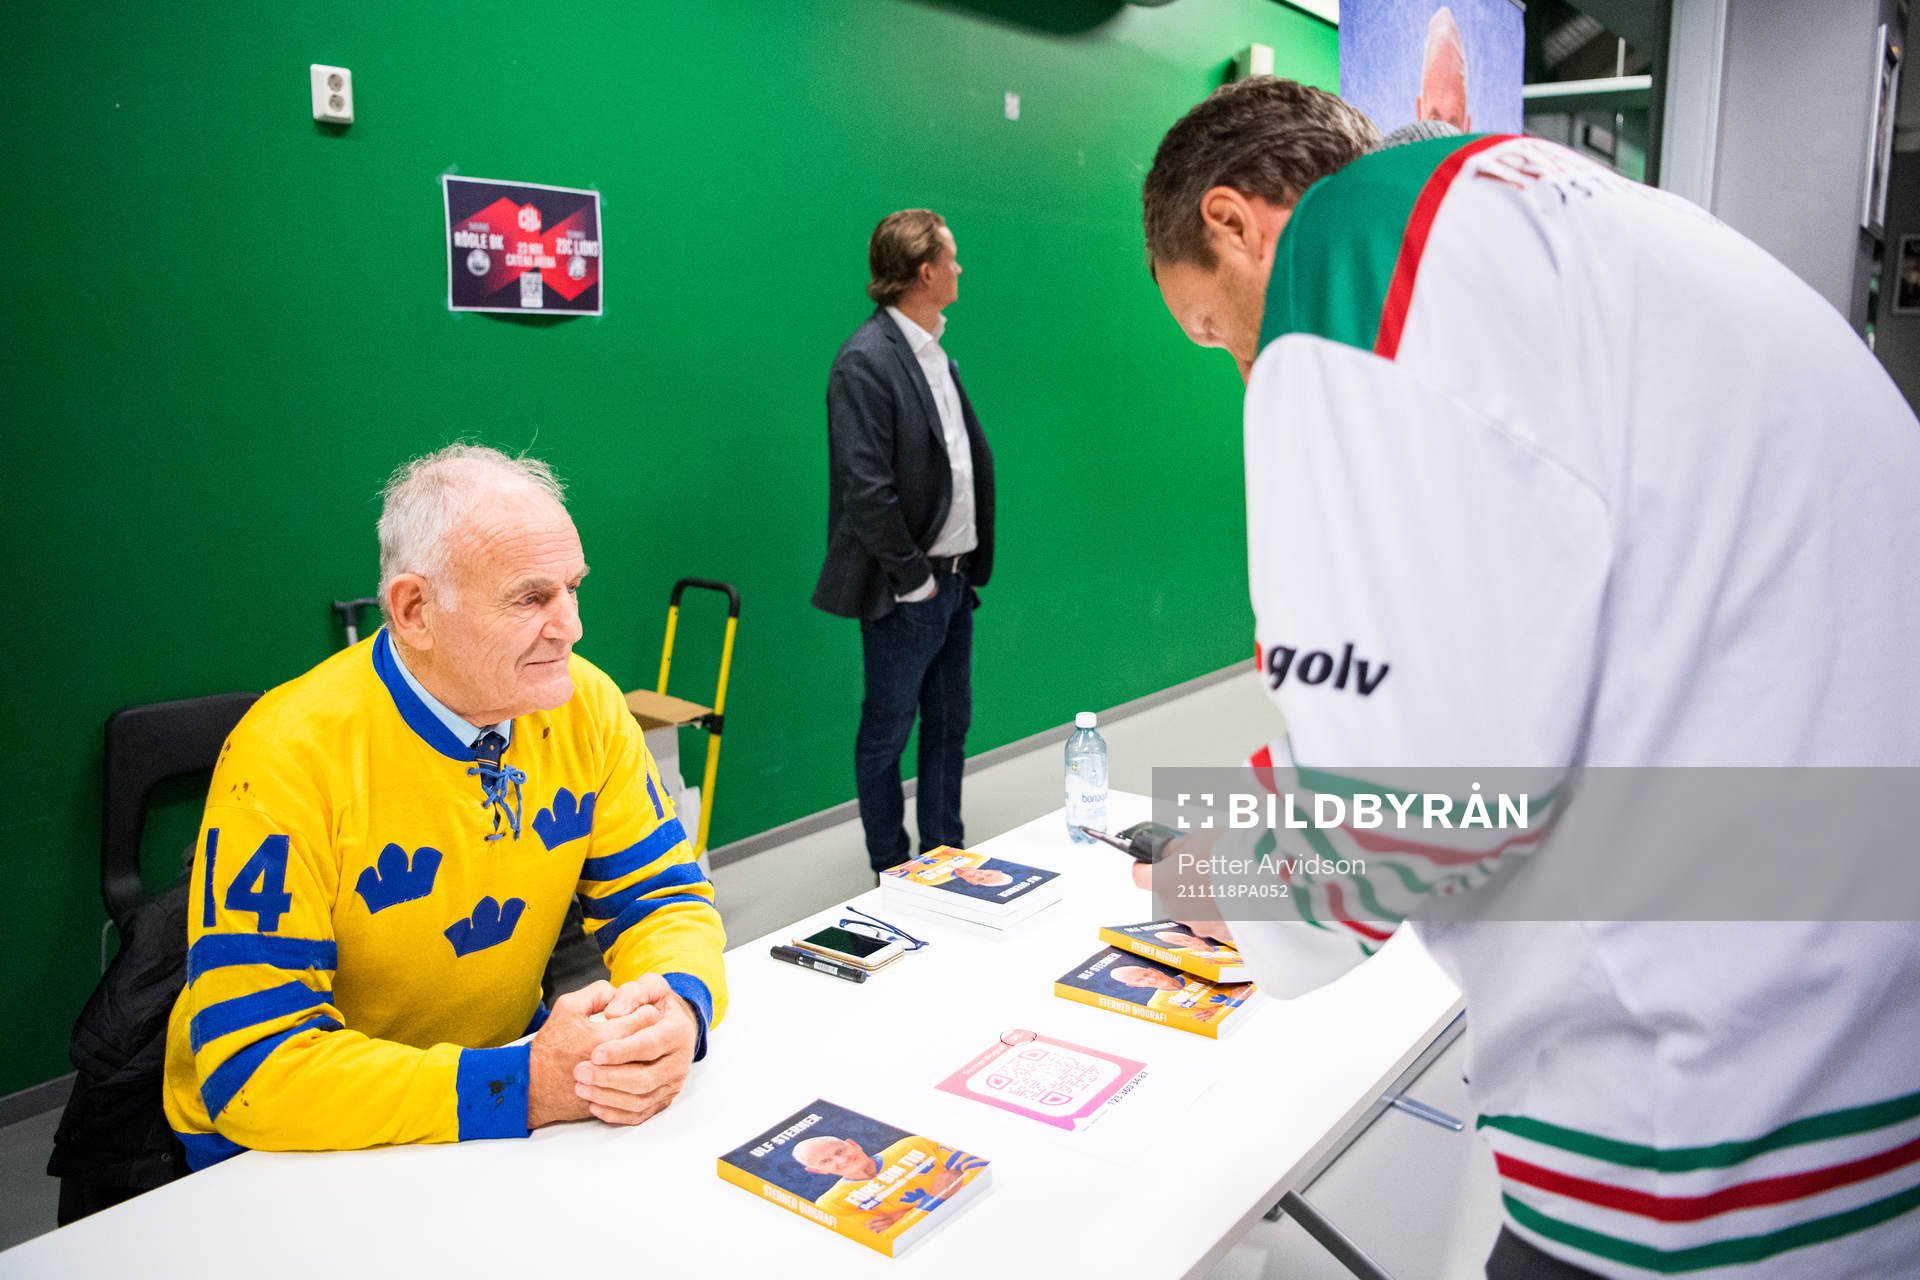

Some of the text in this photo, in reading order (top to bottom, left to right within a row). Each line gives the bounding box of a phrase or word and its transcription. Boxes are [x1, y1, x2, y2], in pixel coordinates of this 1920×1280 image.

[1267, 643, 1390, 696] golv
[202, 828, 293, 933] 14
[1098, 996, 1167, 1024] STERNER BIOGRAFI
[749, 1113, 823, 1157] ULF STERNER
[763, 1184, 838, 1229] STERNER BIOGRAFI
